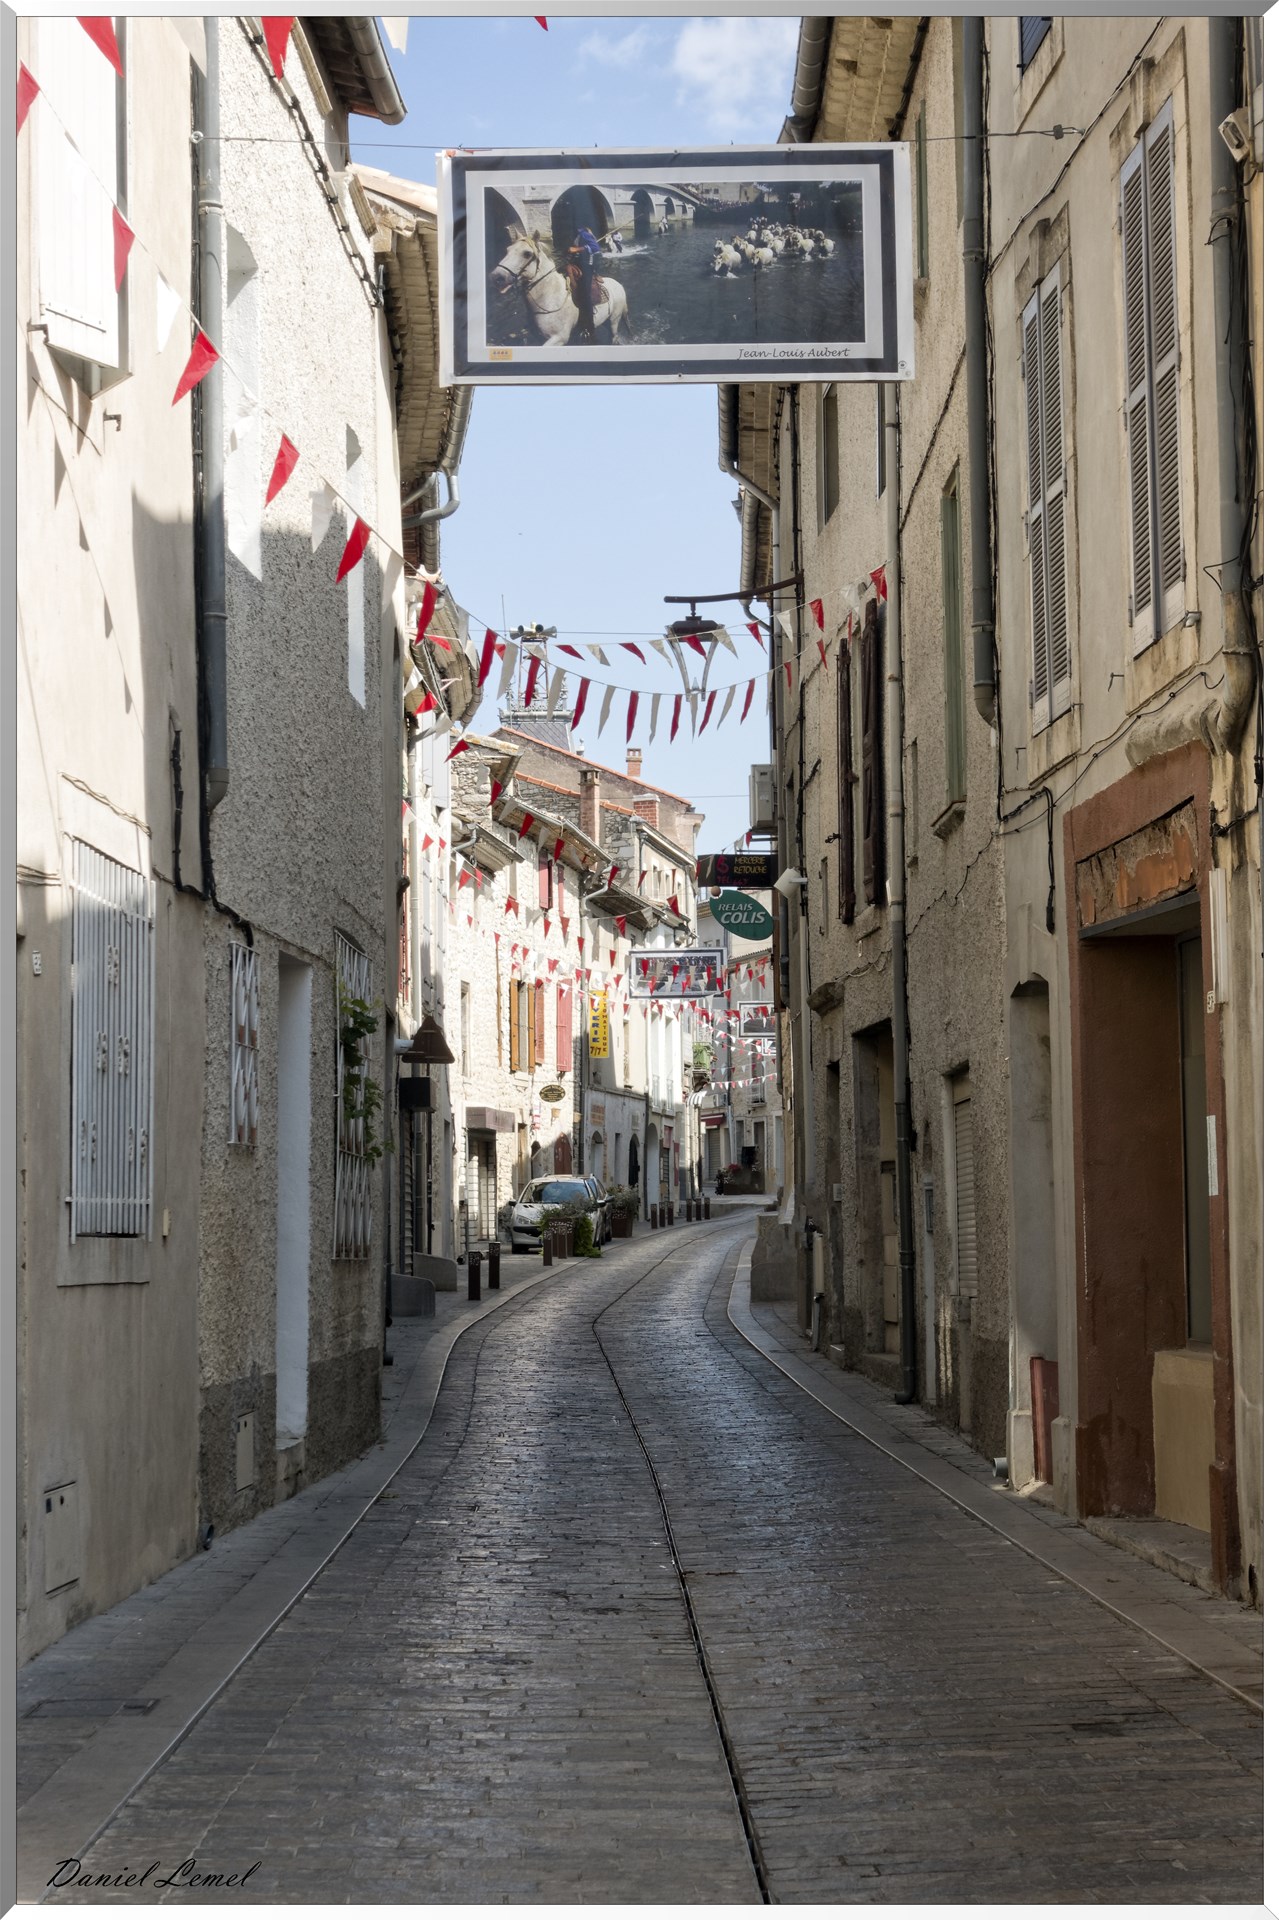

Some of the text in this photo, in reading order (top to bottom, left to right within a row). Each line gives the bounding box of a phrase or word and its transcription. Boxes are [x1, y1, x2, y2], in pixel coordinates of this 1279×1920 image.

[737, 347, 851, 360] Jean-Louis Aubert
[734, 856, 766, 864] MERCERIE
[733, 865, 767, 874] RETOUCHE
[718, 903, 753, 911] RELAIS
[720, 911, 766, 924] COLIS
